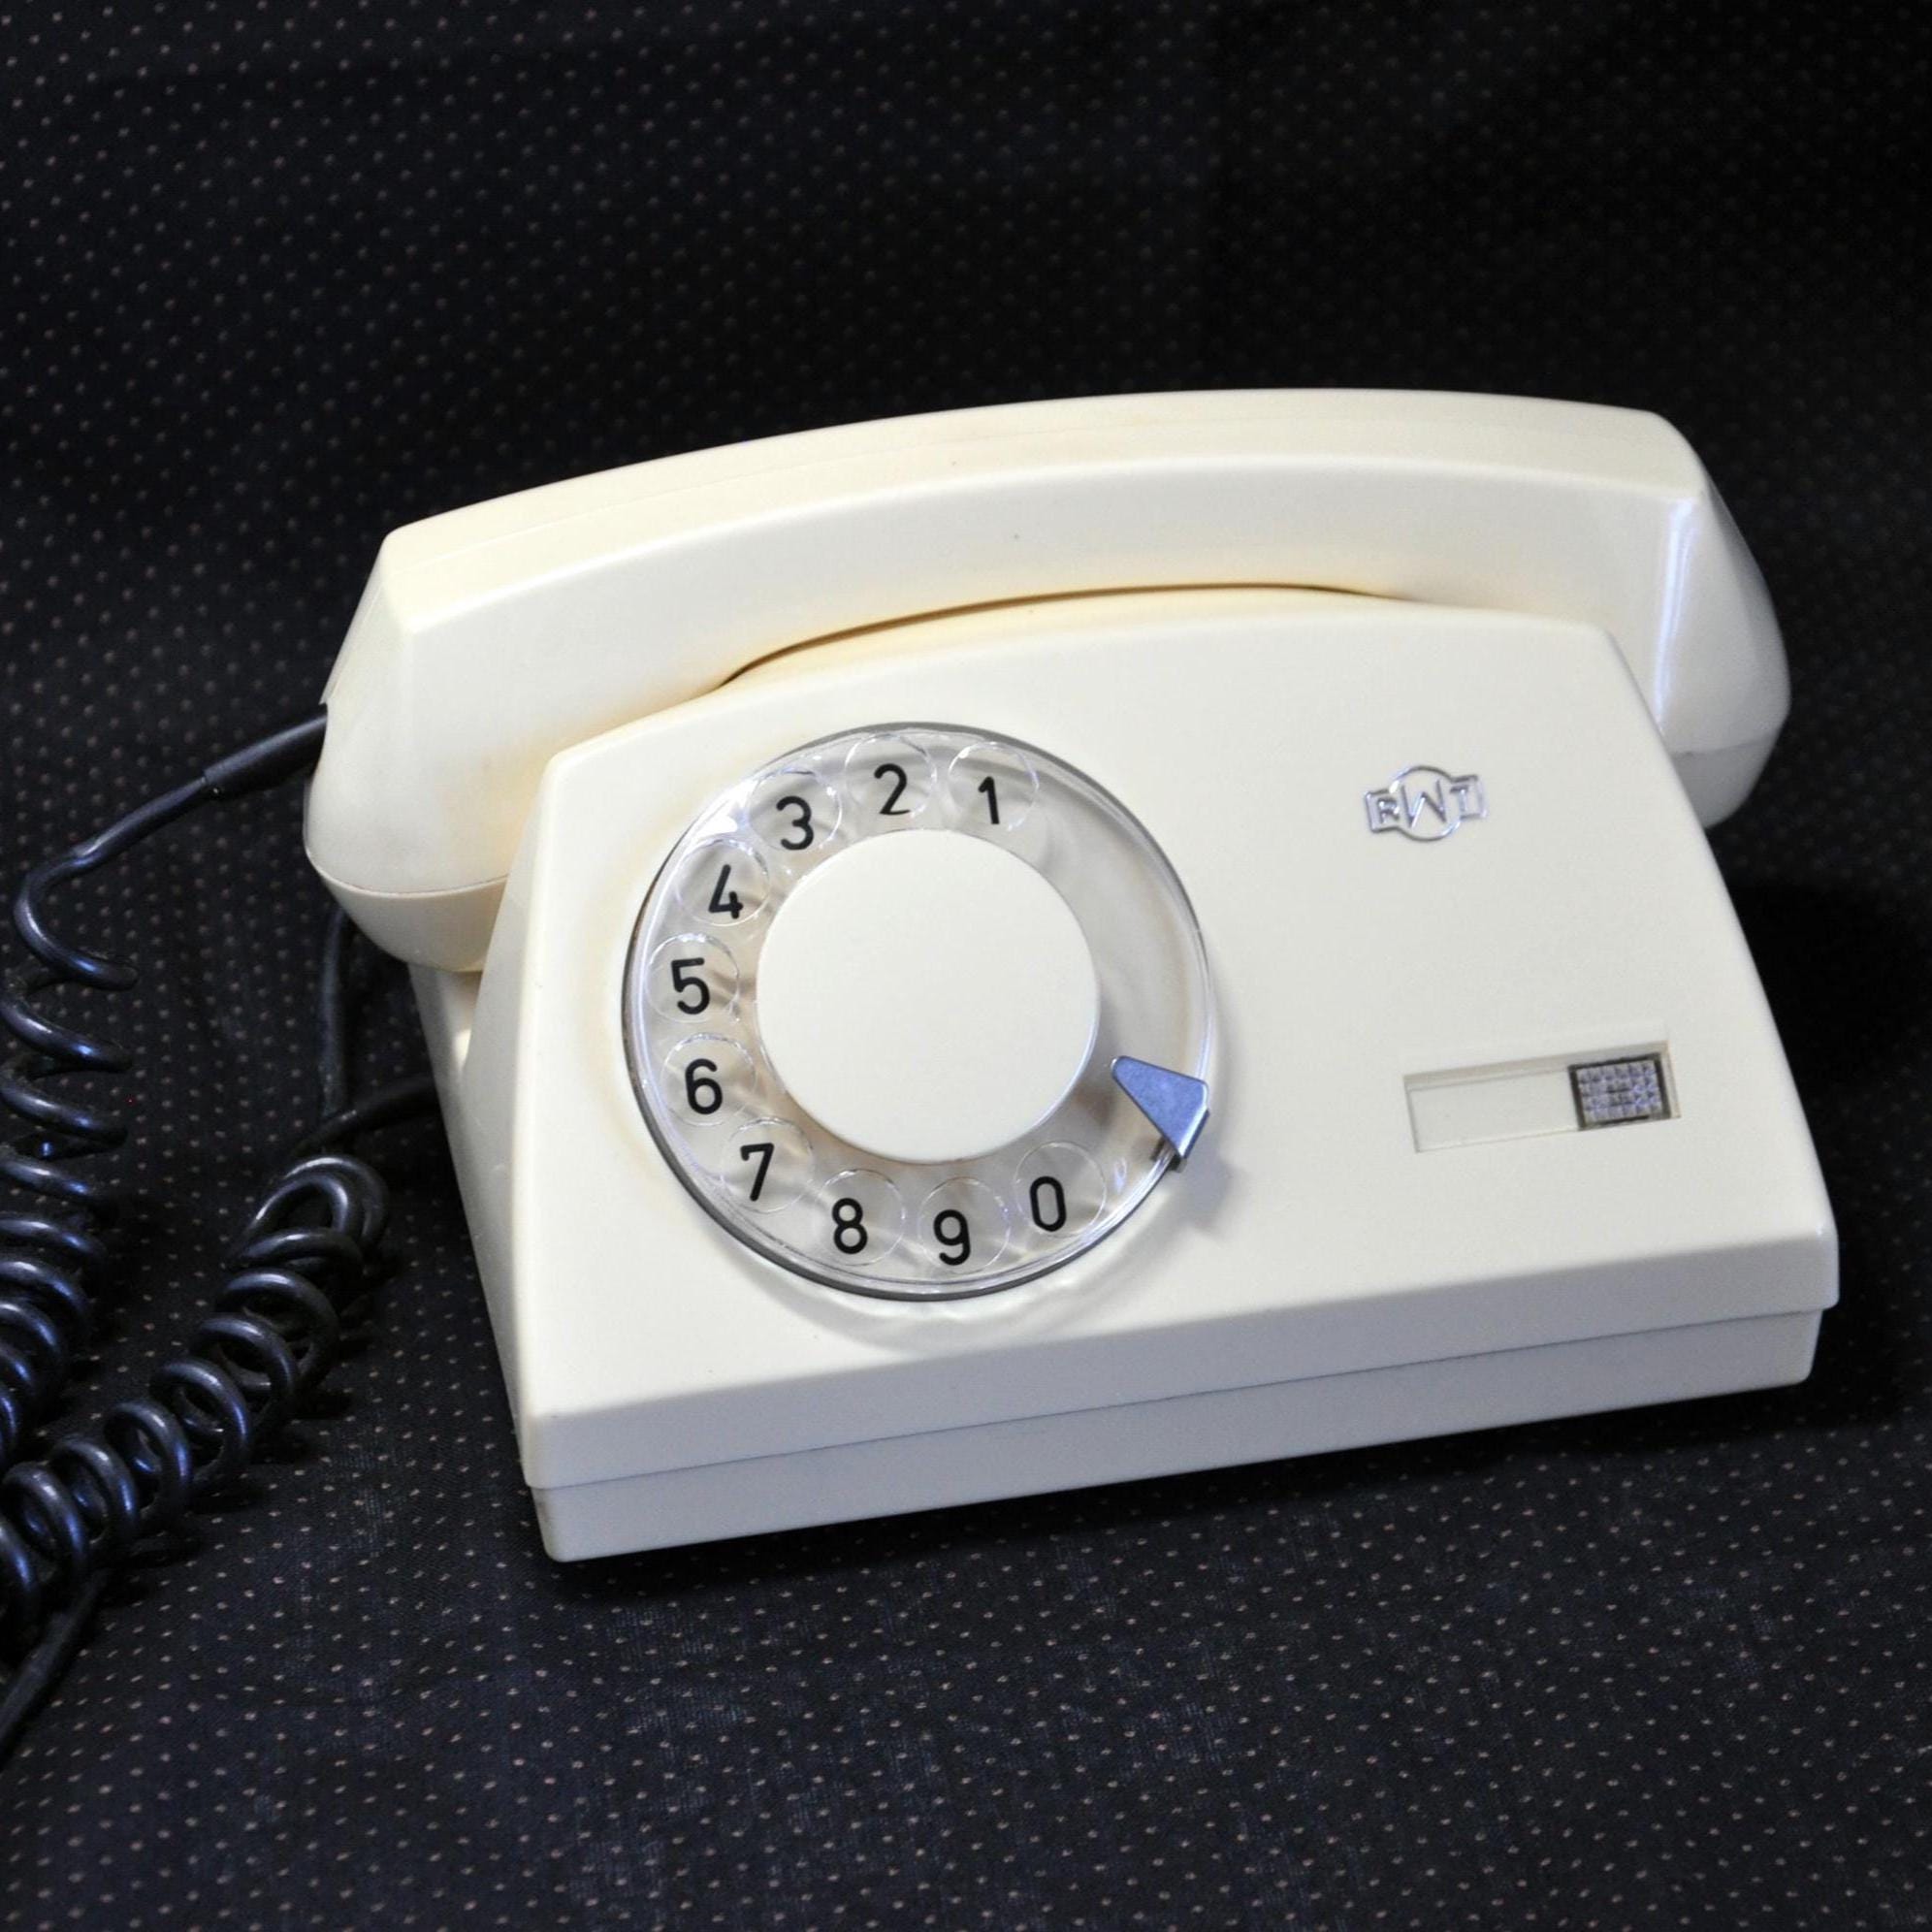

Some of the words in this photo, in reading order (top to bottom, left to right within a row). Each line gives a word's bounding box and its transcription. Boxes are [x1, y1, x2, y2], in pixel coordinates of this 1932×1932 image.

[873, 762, 910, 816] 2
[978, 776, 1000, 825] 1
[1374, 778, 1472, 829] RWT
[775, 795, 815, 851] 3
[708, 864, 744, 919] 4
[670, 957, 711, 1015] 5
[685, 1058, 724, 1115] 6
[740, 1142, 775, 1203] 7
[831, 1197, 869, 1255] 8
[1028, 1175, 1068, 1233] 0
[932, 1208, 972, 1267] 9
